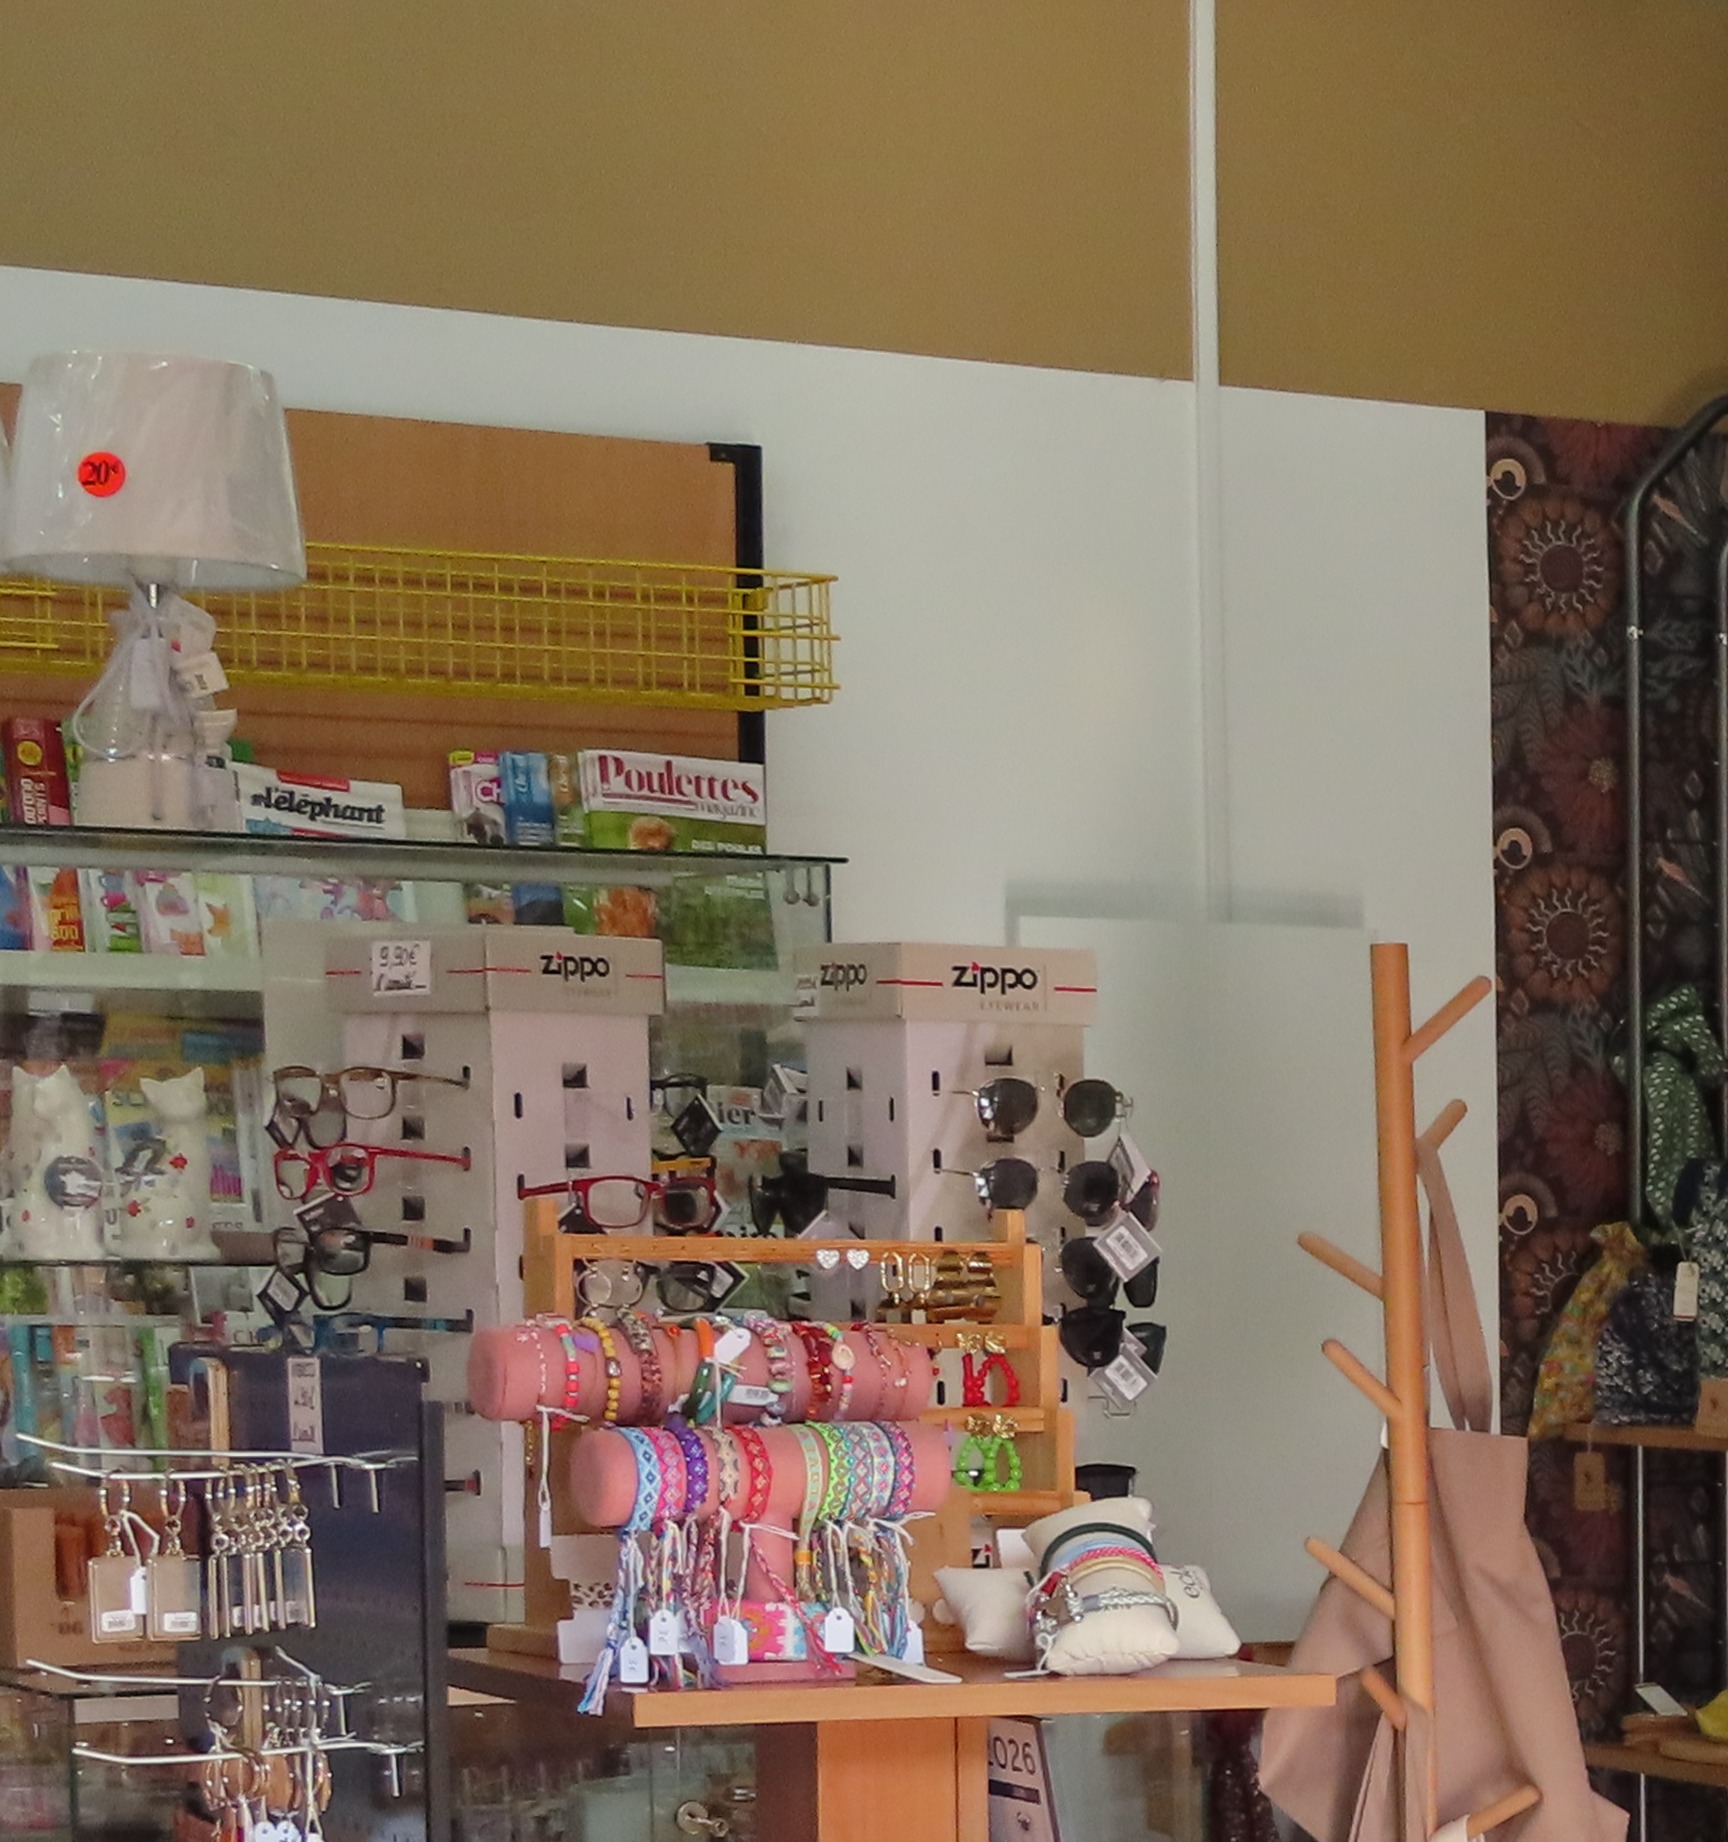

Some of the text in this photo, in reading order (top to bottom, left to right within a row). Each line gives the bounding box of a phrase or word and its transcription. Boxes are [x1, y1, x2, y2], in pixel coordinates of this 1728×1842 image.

[598, 754, 759, 803] Poulettes
[979, 1001, 1040, 1012] EYEWEAR
[988, 1736, 1036, 1776] 026
